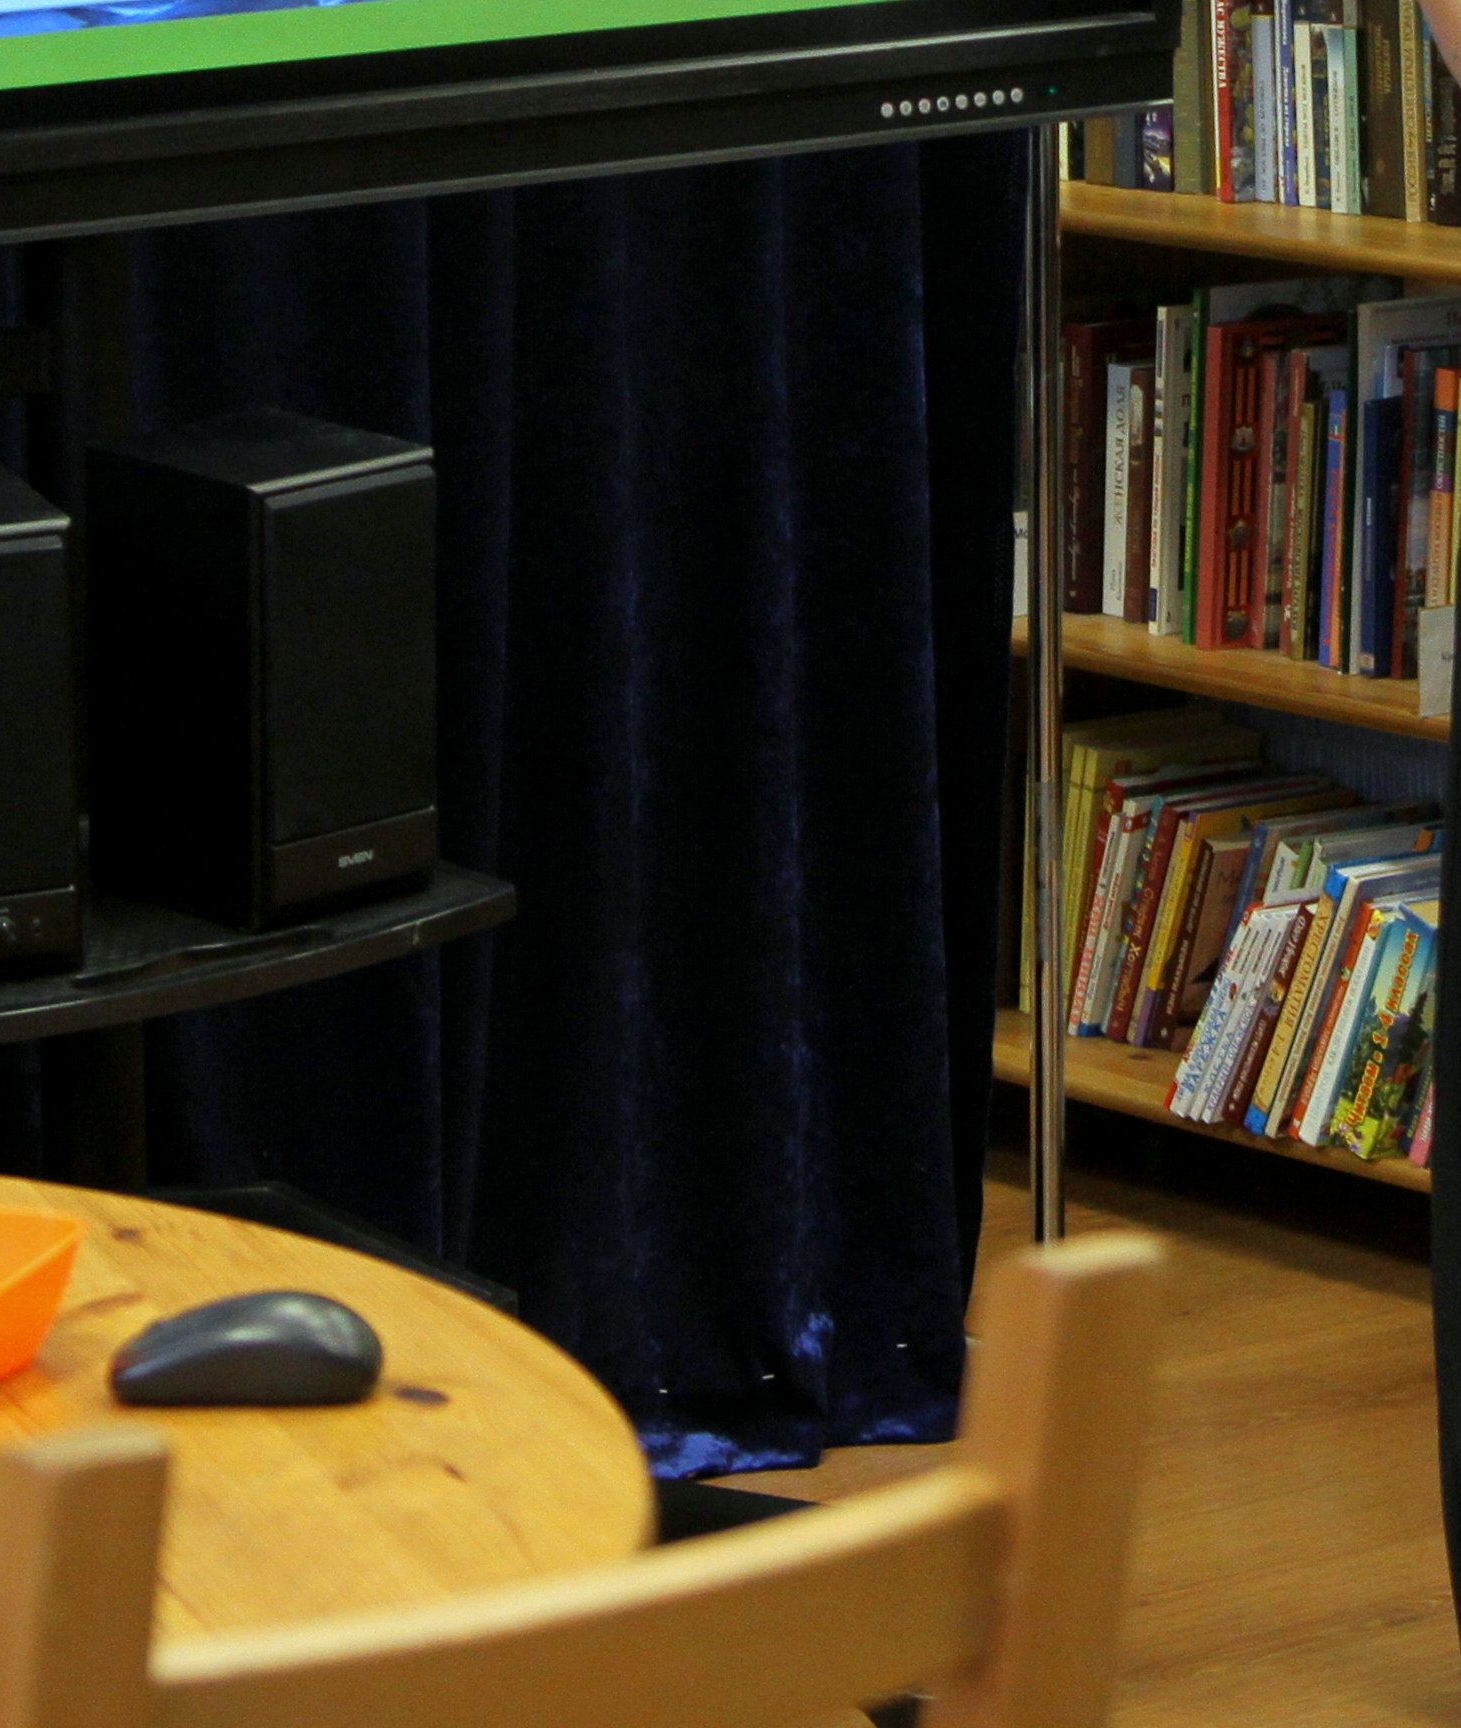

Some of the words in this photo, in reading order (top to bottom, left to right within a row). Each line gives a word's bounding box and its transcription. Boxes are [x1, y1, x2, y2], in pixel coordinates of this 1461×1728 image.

[1217, 20, 1228, 89] МУЖЕСТВА
[1113, 384, 1127, 435] ДОЛЯ
[1111, 436, 1127, 527] ЖЕНСКАЯ
[338, 849, 374, 869] SVEN
[1281, 911, 1332, 1030] ХРЕСТОМАТИЯ
[1344, 1061, 1381, 1127] Читаем
